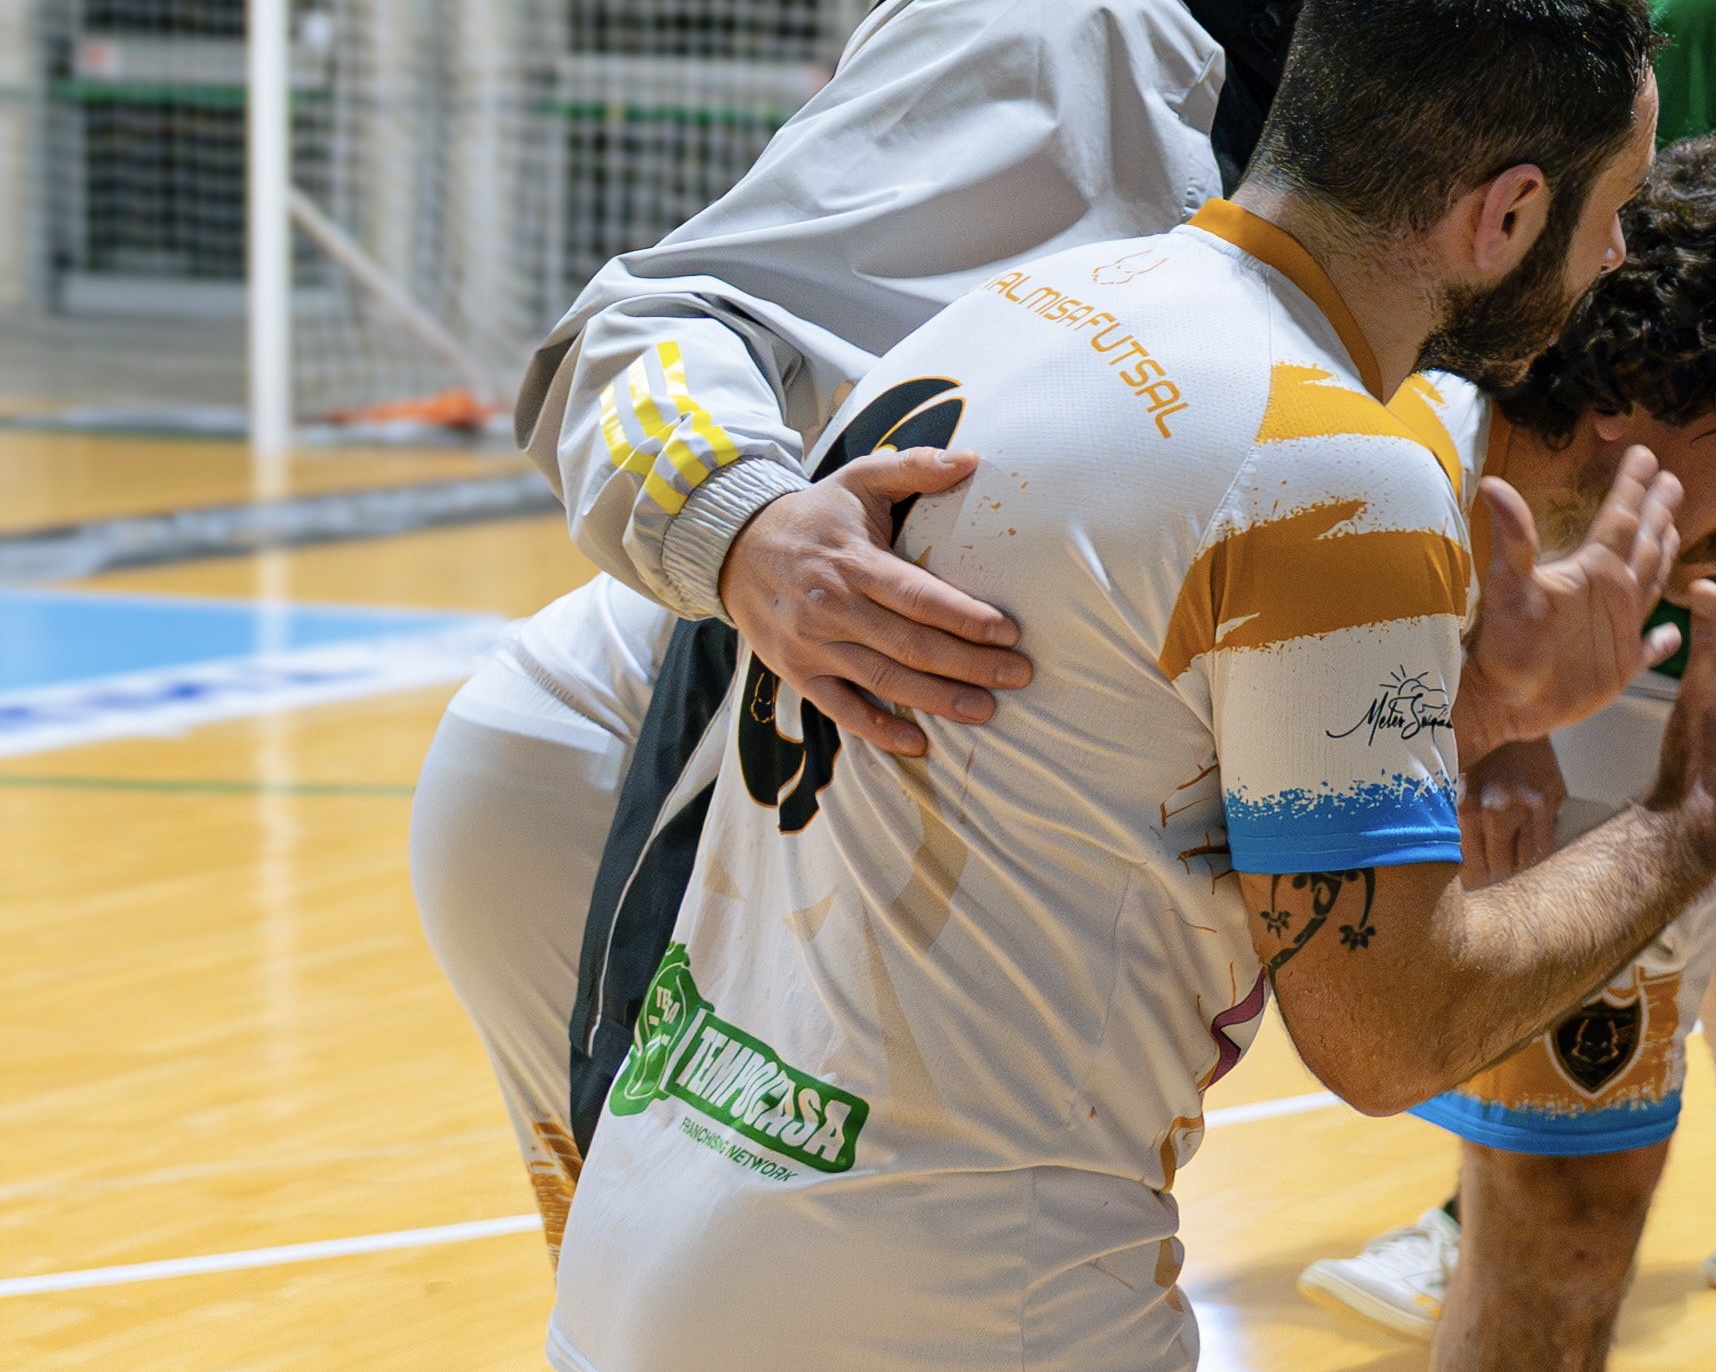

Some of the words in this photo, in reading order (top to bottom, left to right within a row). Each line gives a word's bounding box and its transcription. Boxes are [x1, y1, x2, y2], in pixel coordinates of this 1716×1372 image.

[981, 271, 1095, 328] ALMISA
[1073, 312, 1189, 438] FUTSAL
[725, 1144, 799, 1183] NETWORK
